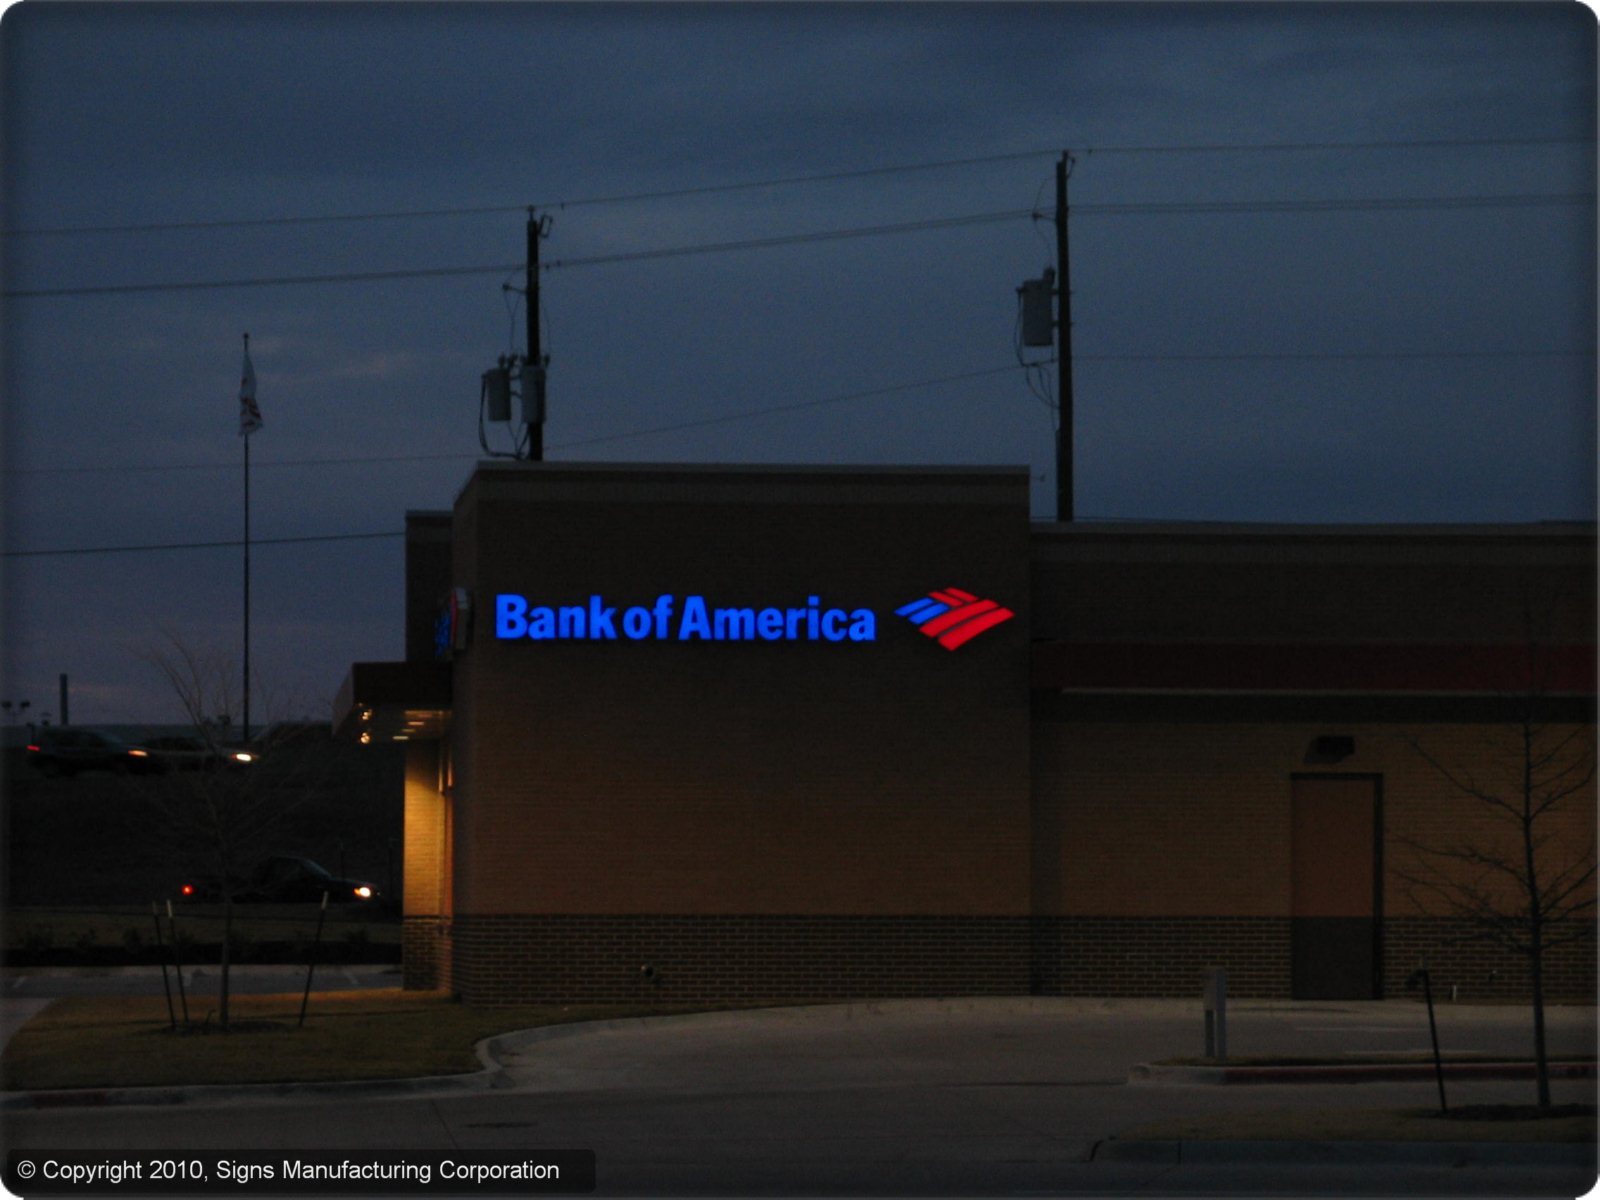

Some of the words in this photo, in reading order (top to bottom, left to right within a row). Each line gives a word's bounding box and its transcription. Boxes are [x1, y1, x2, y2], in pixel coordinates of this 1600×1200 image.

[495, 594, 617, 640] Bank
[623, 594, 674, 640] of
[678, 595, 876, 641] America
